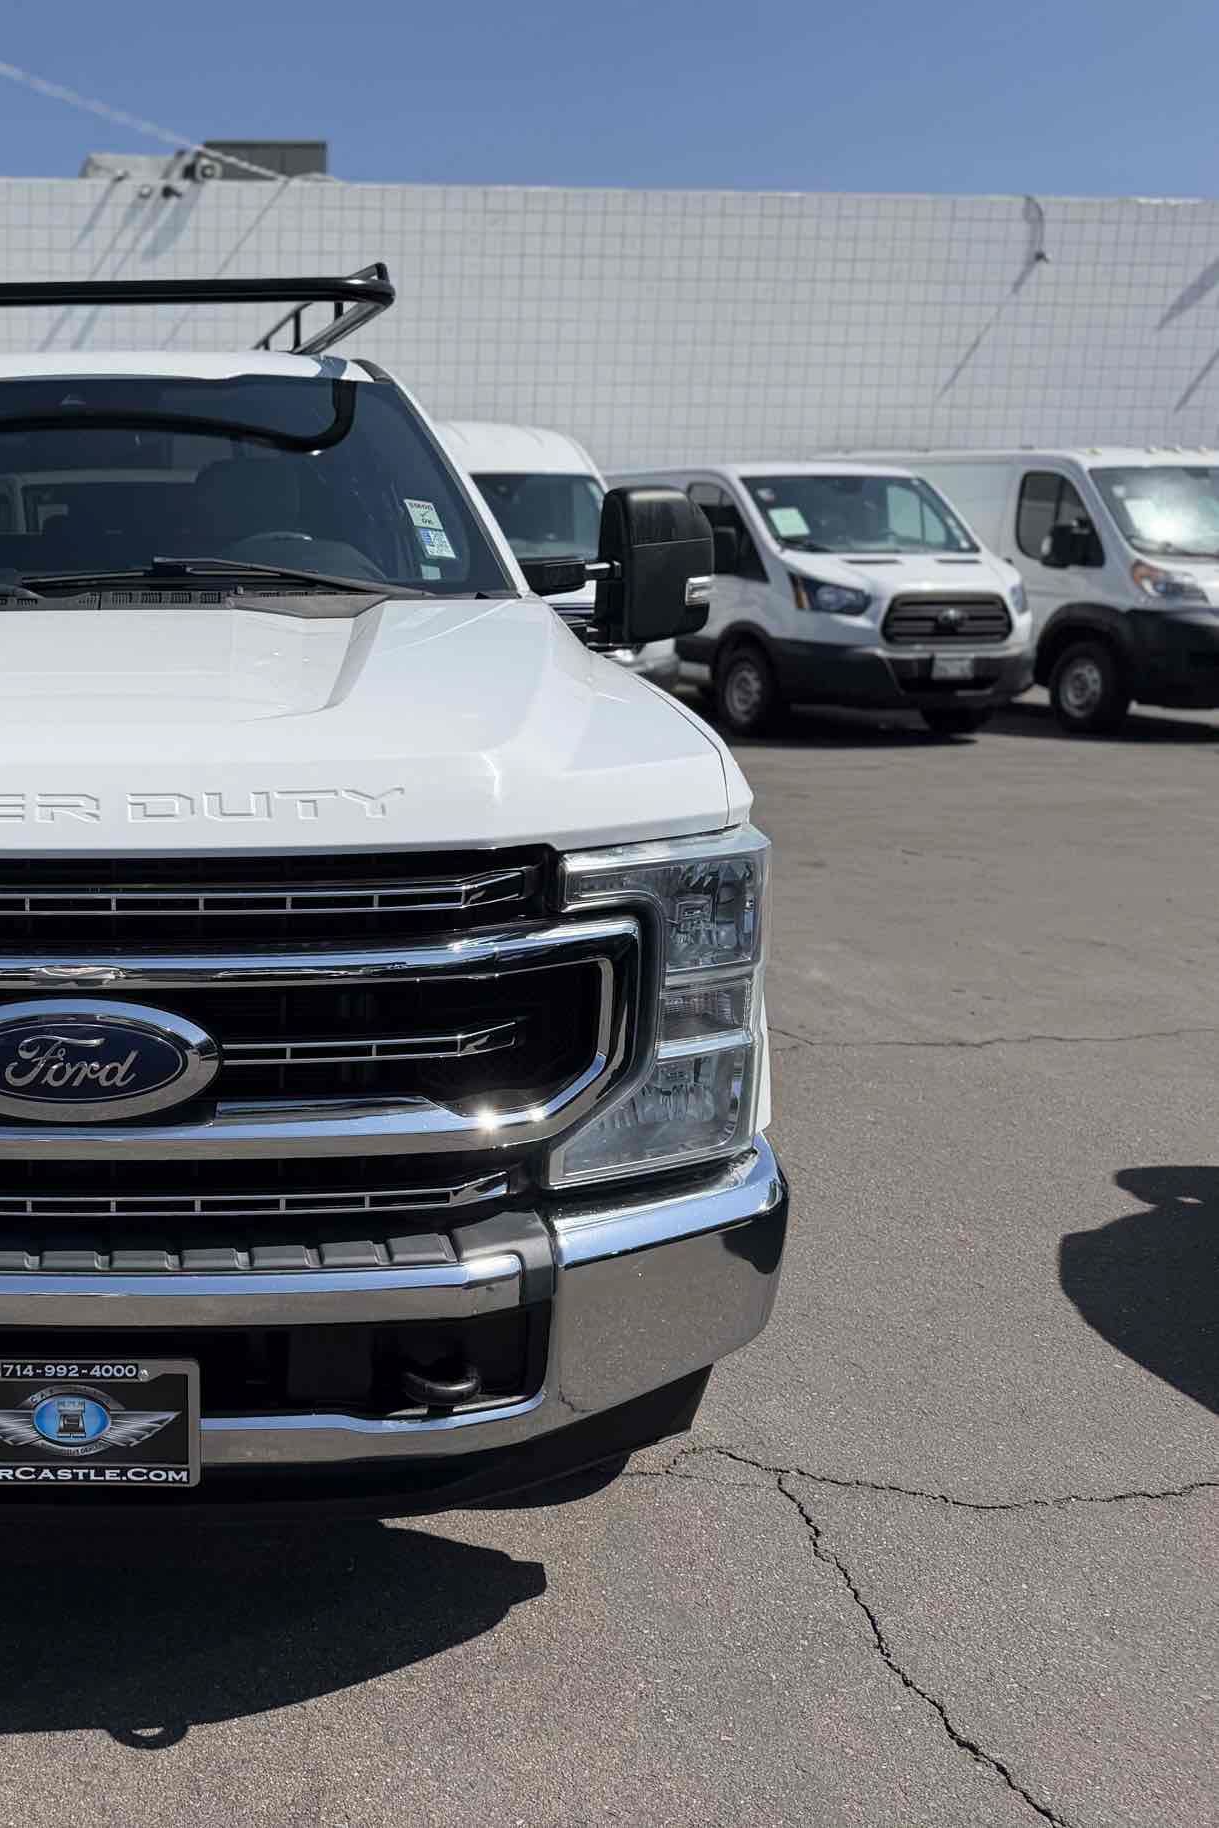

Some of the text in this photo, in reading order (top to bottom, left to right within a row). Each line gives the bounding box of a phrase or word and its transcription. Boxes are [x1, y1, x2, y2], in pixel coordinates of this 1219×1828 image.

[125, 786, 406, 823] DUTY
[4, 1035, 138, 1088] Ford
[2, 1363, 138, 1379] 714-992-4000
